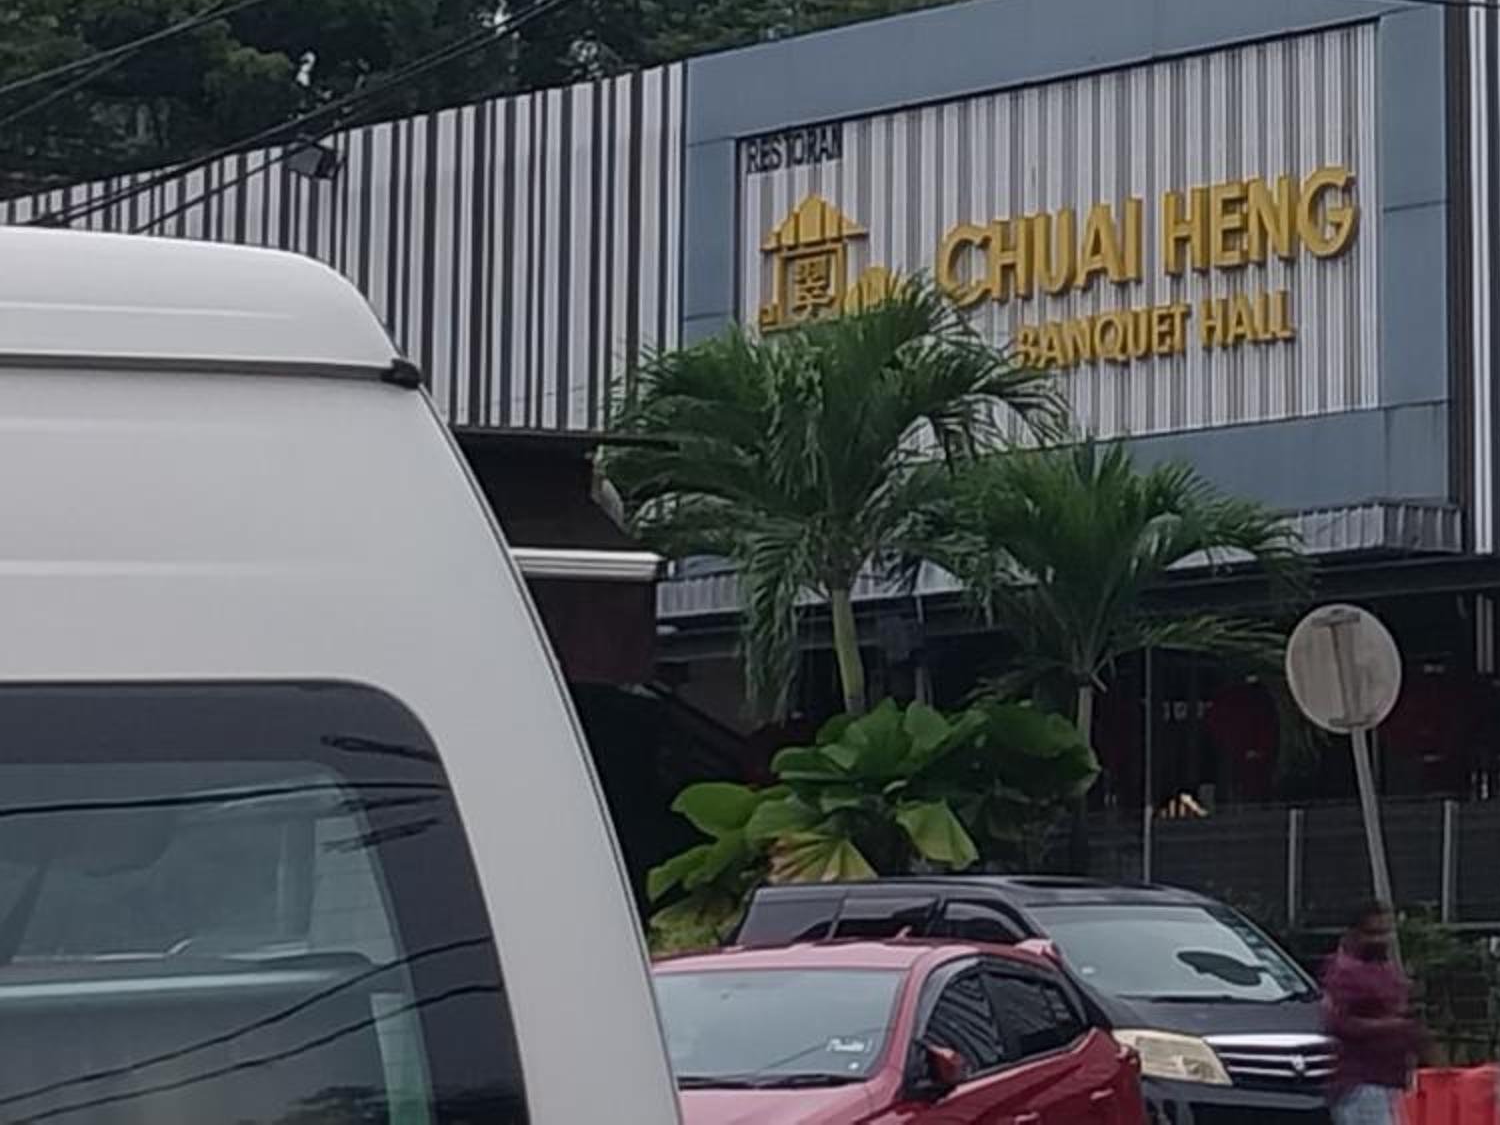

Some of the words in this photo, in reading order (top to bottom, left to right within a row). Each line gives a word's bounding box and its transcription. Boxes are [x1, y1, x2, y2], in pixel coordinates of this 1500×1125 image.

[747, 125, 843, 174] RESTORAN
[935, 196, 1142, 308] CHUAI
[1164, 166, 1360, 276] HENG
[1015, 300, 1191, 372] BANQUET
[1203, 289, 1294, 349] HALL
